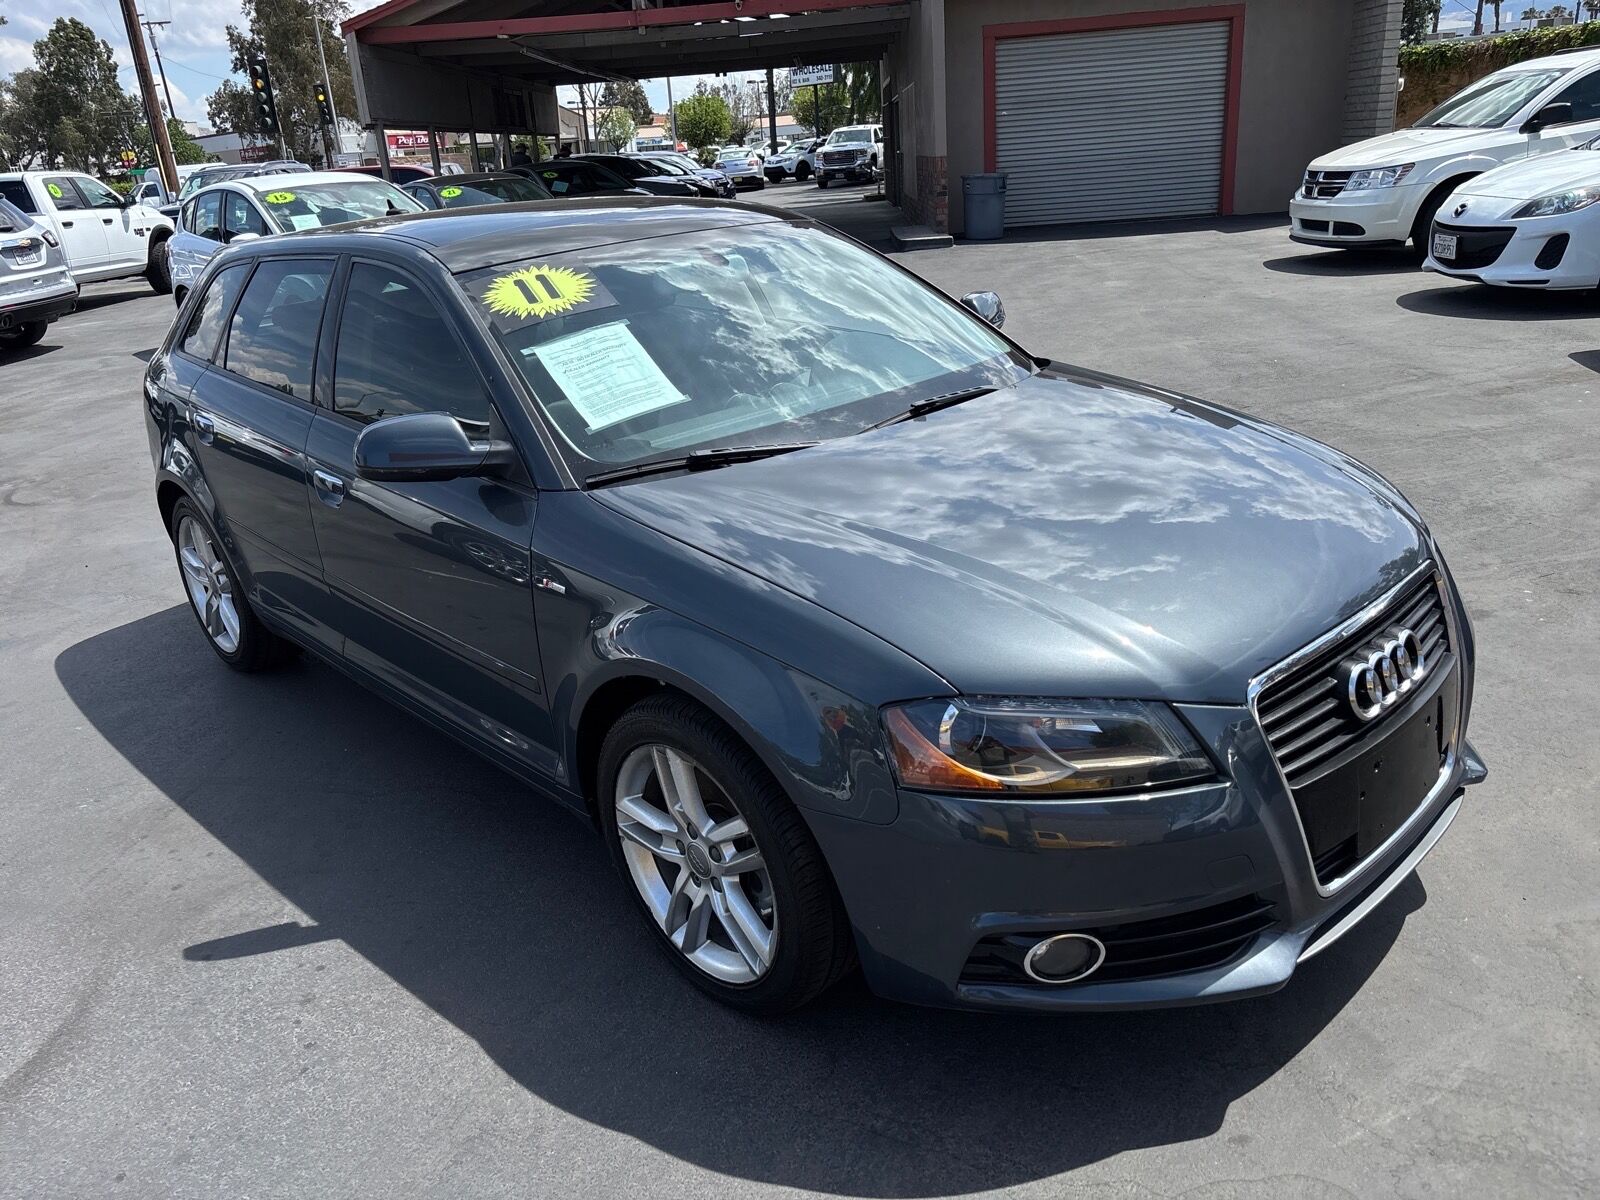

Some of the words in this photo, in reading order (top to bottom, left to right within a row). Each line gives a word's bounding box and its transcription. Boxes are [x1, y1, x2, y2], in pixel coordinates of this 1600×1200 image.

[792, 64, 833, 76] WHOLESALE
[273, 193, 287, 201] 15
[513, 274, 564, 304] 11
